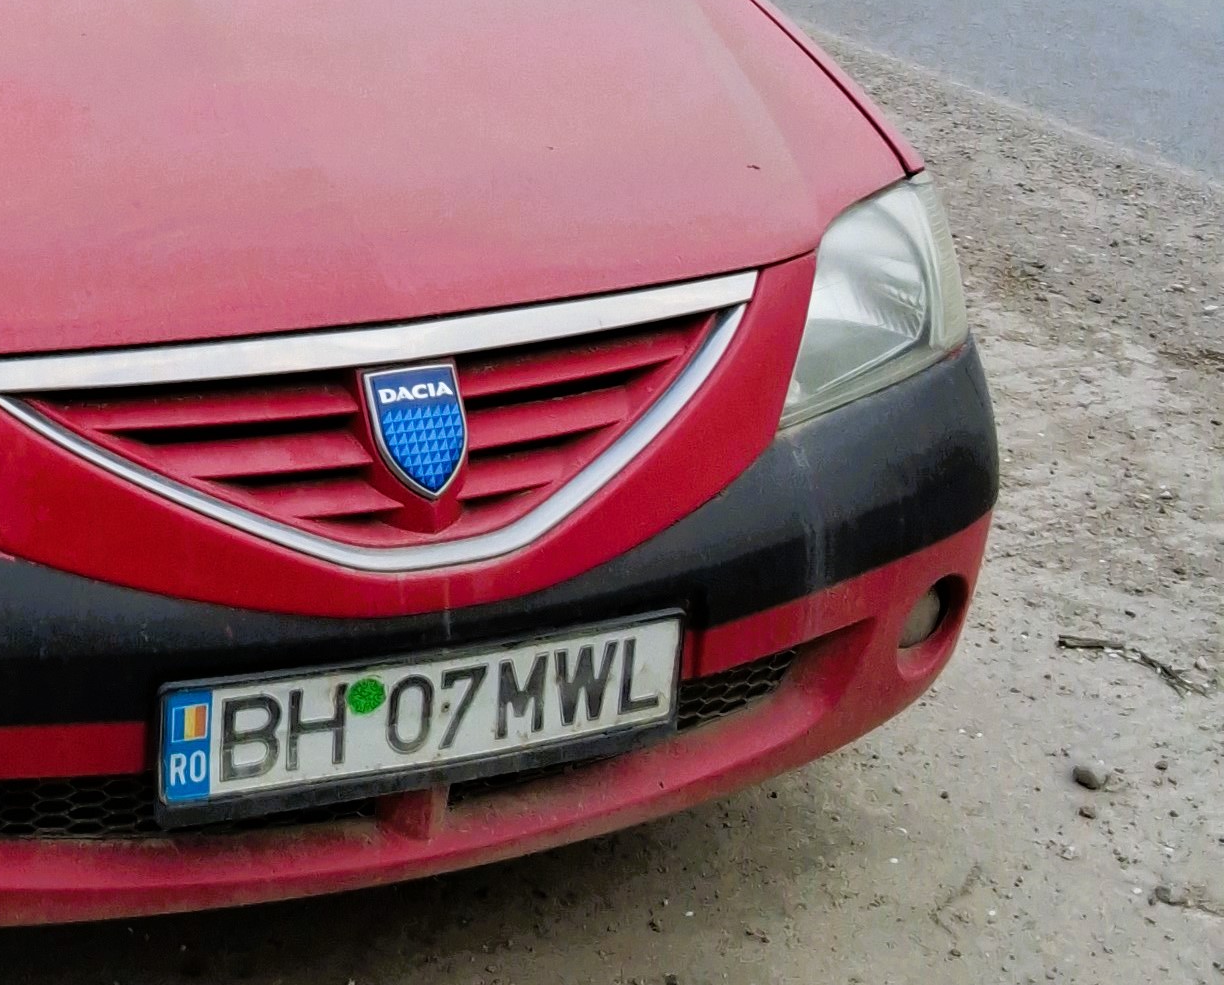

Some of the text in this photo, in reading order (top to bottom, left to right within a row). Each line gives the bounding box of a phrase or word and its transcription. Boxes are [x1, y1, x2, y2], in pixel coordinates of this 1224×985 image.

[378, 382, 453, 404] DACIA
[220, 636, 660, 782] BH 07 MWL
[170, 750, 207, 786] RO
